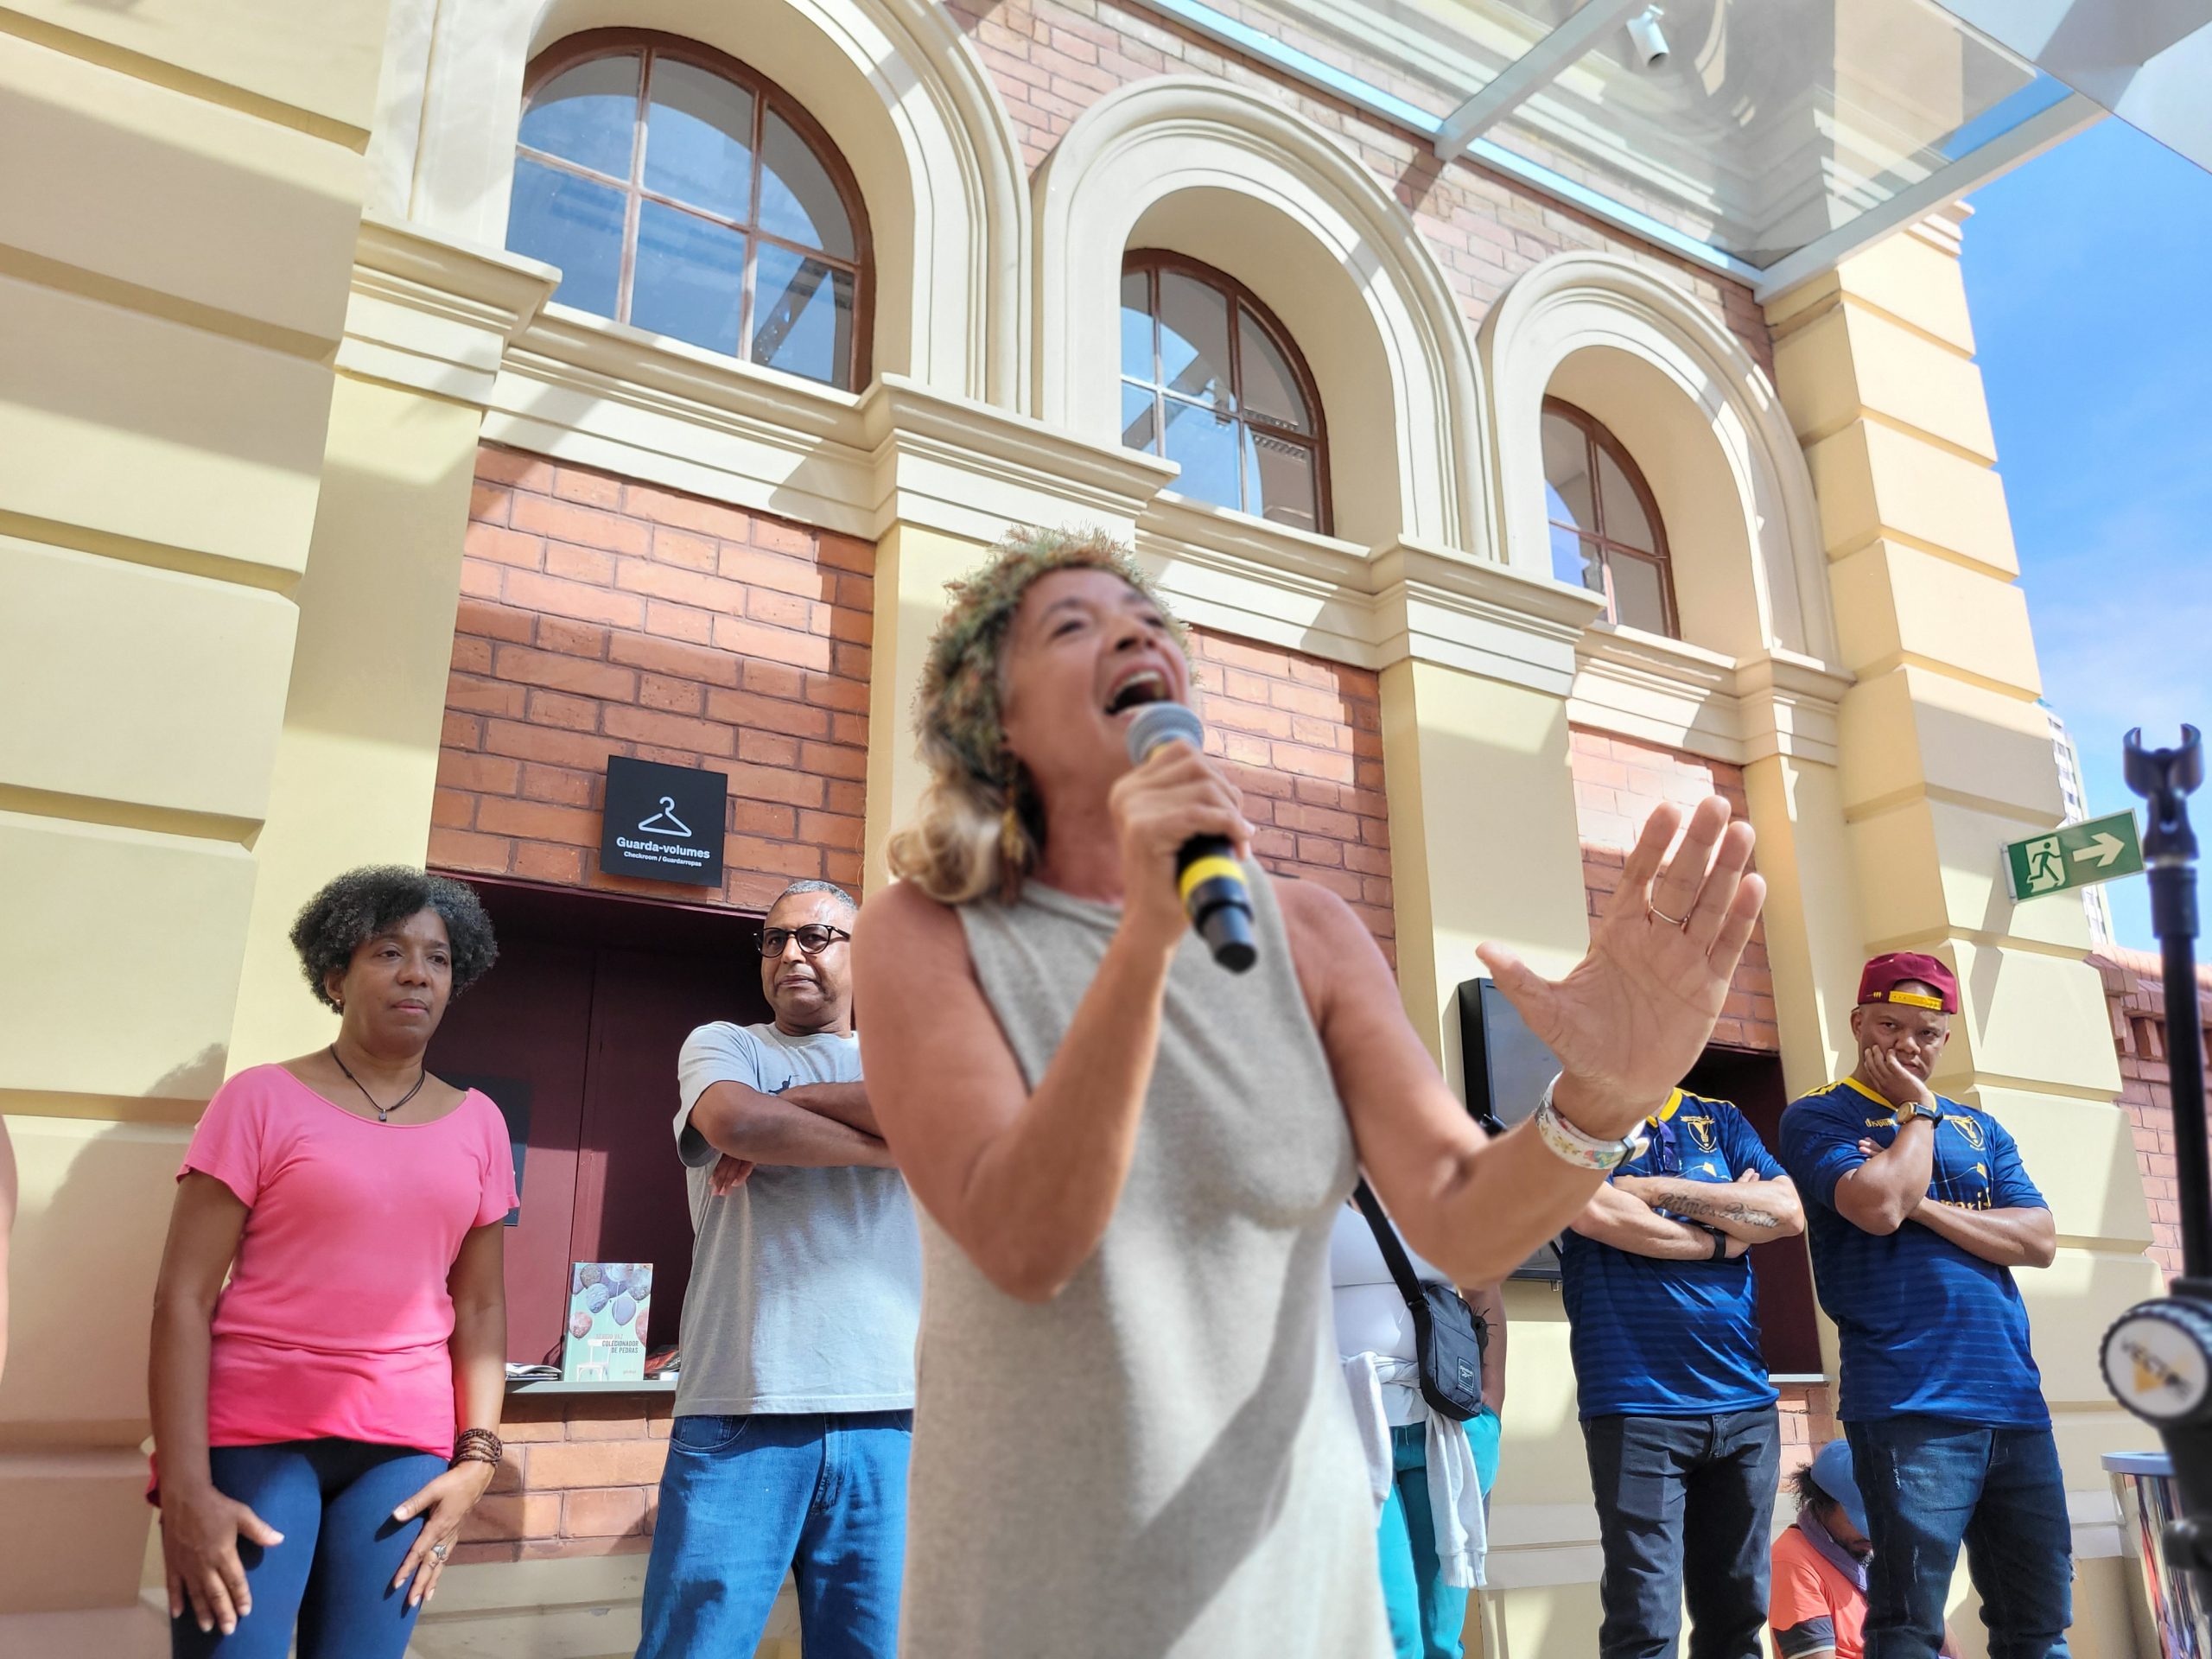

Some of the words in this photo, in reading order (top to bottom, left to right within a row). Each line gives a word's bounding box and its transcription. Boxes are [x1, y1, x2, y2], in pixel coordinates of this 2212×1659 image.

[616, 836, 710, 859] Guarda-volumes
[624, 851, 658, 861] Checkroom
[662, 856, 702, 867] Guardarropas
